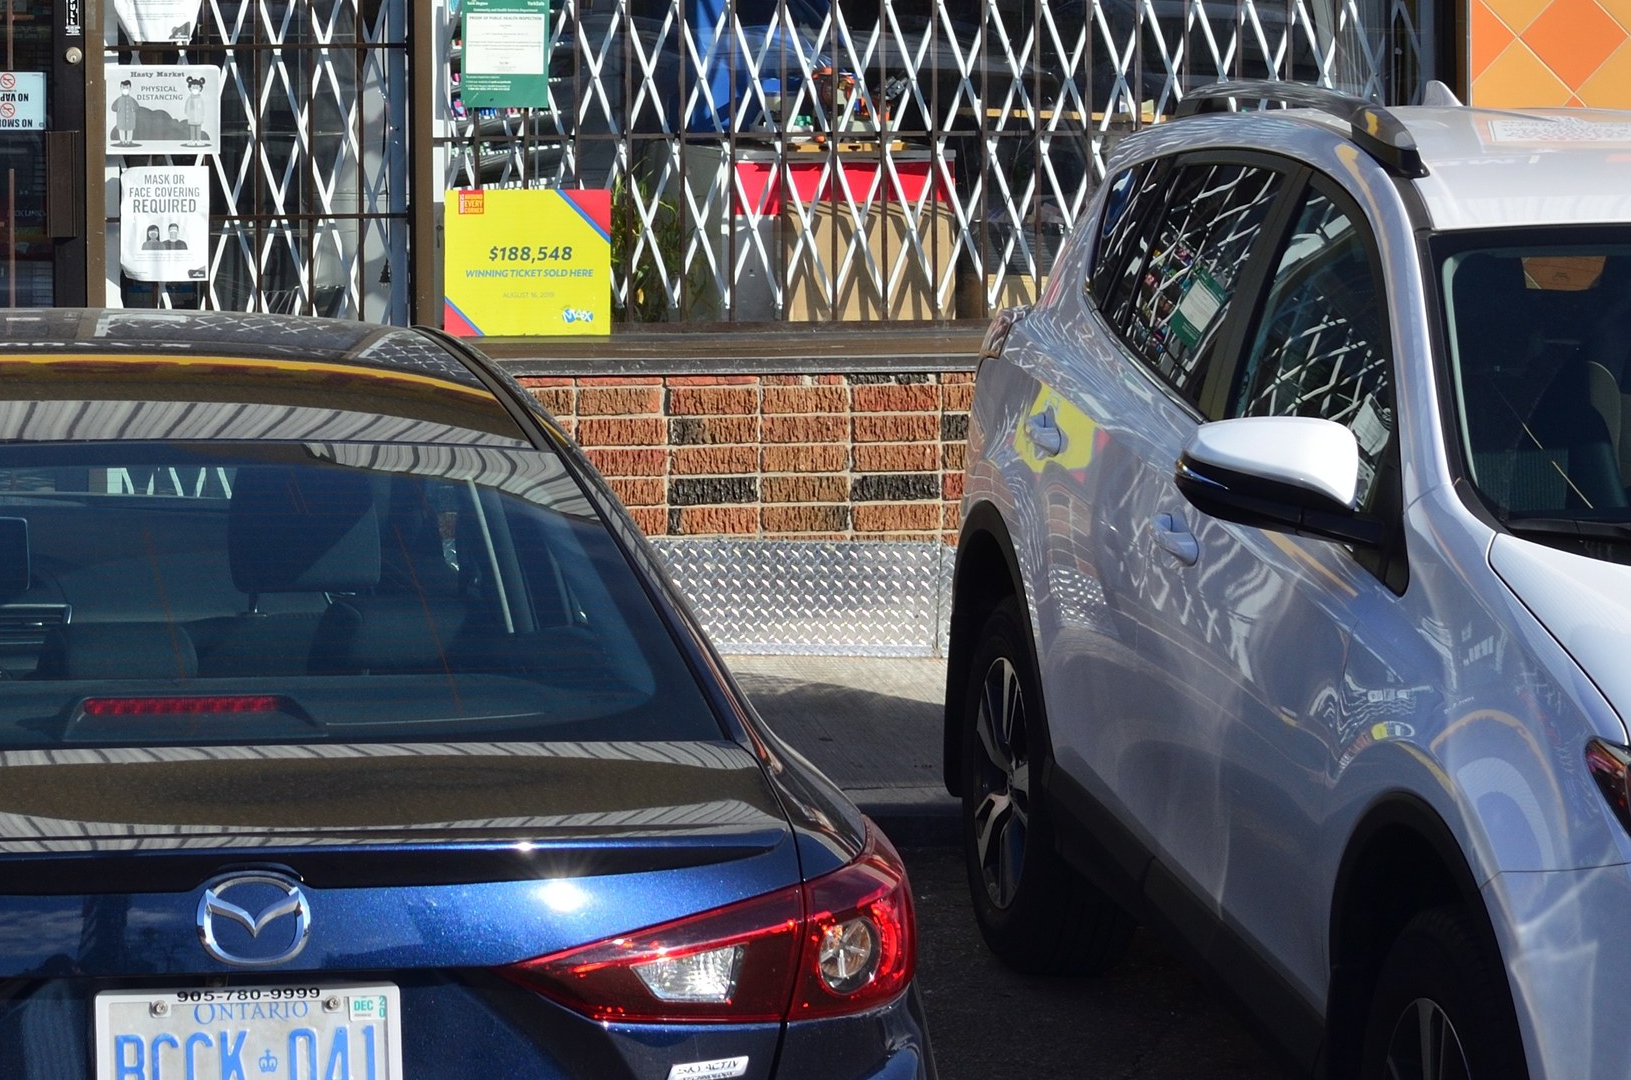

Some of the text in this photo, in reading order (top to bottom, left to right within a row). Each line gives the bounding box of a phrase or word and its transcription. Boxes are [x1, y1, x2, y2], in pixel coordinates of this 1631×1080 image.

[17, 92, 29, 102] NO
[21, 118, 33, 128] NO
[144, 174, 185, 185] MASK OR
[129, 186, 200, 198] FACE COVERING
[133, 198, 197, 214] REQUIRED
[488, 246, 573, 263] $188,548
[465, 269, 593, 278] WINNING TICKET SOLD HERE
[176, 987, 320, 1003] 905-780-9999
[354, 1000, 373, 1011] DEC
[193, 1000, 309, 1025] ONTARIO
